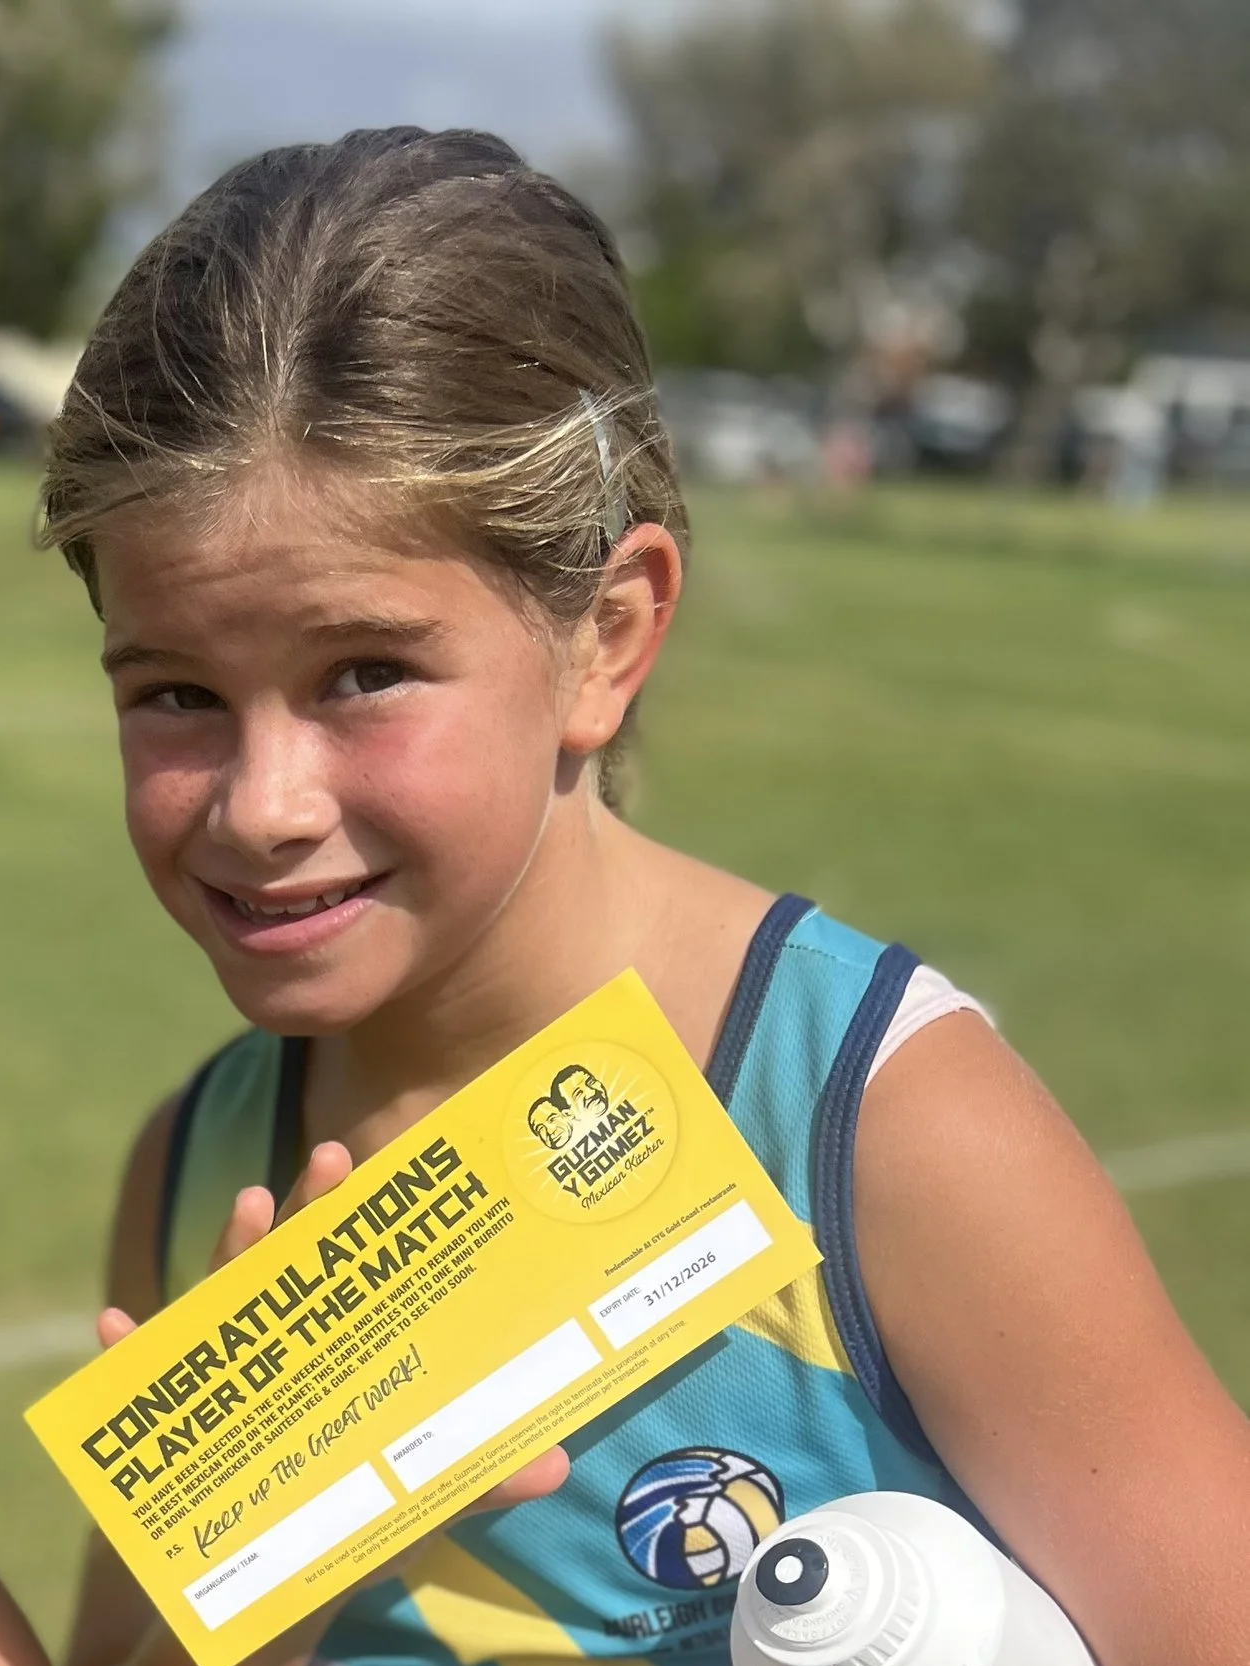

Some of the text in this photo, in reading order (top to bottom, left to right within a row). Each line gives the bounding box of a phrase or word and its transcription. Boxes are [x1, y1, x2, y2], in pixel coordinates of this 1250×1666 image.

[547, 1099, 638, 1183] GUZMAN
[562, 1115, 655, 1197] Y GOMEZ
[581, 1139, 664, 1210] Mexican Kitchen
[80, 1136, 462, 1470] CONGRATULATIONS
[109, 1170, 488, 1501] PLAYER OF THE MATCH
[131, 1196, 510, 1518] YOU HAVE BEEN SELECTED AS THE GYG WEEKLY HERO, AND WE WANT TO REWARD YOU WITH
[643, 1251, 716, 1306] 31/12/2026
[140, 1212, 513, 1529] THE BEST MEXICAN FOOD ON THE PLANET; THIS CARD ENTITLES YOU TO ONE MINI BURRITO
[150, 1263, 476, 1540] OR BOWL WITH CHICKEN OR SAUTÉED VEG & GUAC. WE HOPE TO SEE YOU SOON.
[165, 1543, 184, 1559] P.S.
